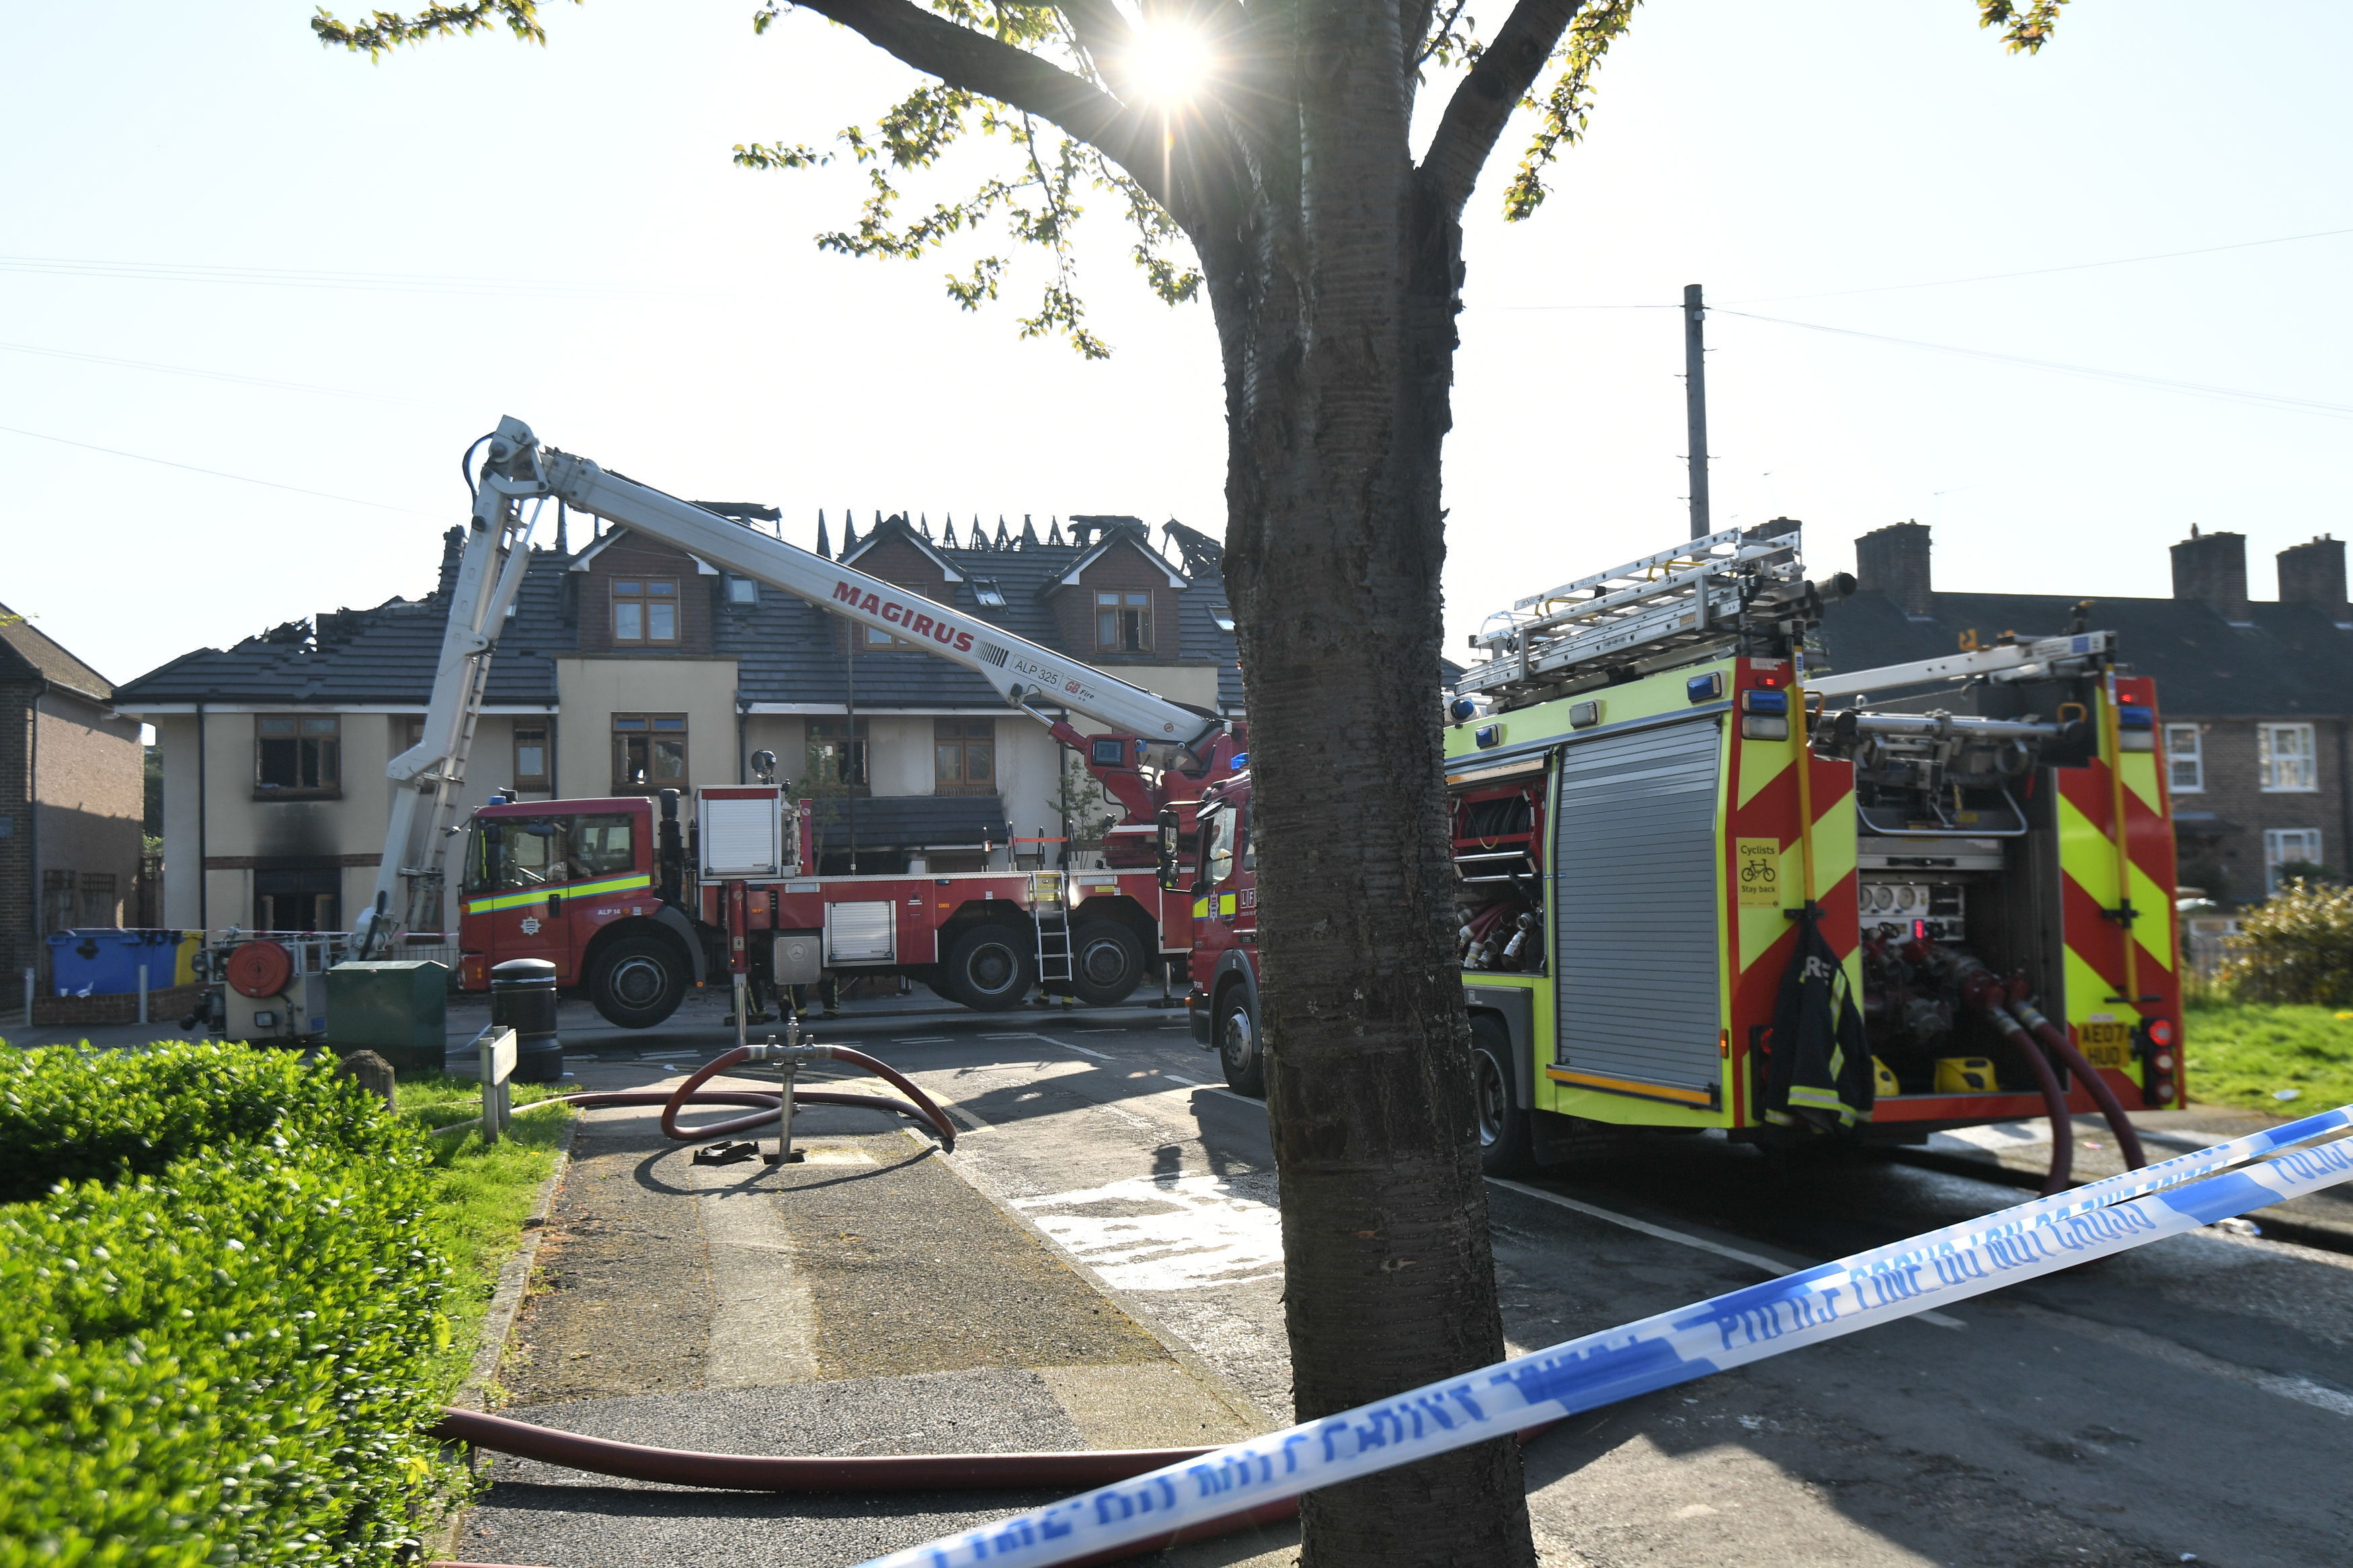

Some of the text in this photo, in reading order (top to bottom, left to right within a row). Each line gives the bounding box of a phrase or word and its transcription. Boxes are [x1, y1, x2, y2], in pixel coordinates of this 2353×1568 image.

[833, 581, 974, 652] MAGIRUS
[1014, 661, 1058, 684] ALP 325
[1065, 681, 1094, 699] GB Fire
[1741, 845, 1775, 856] Cyclists
[1741, 885, 1757, 895] Stay
[2083, 1024, 2124, 1043] AE07
